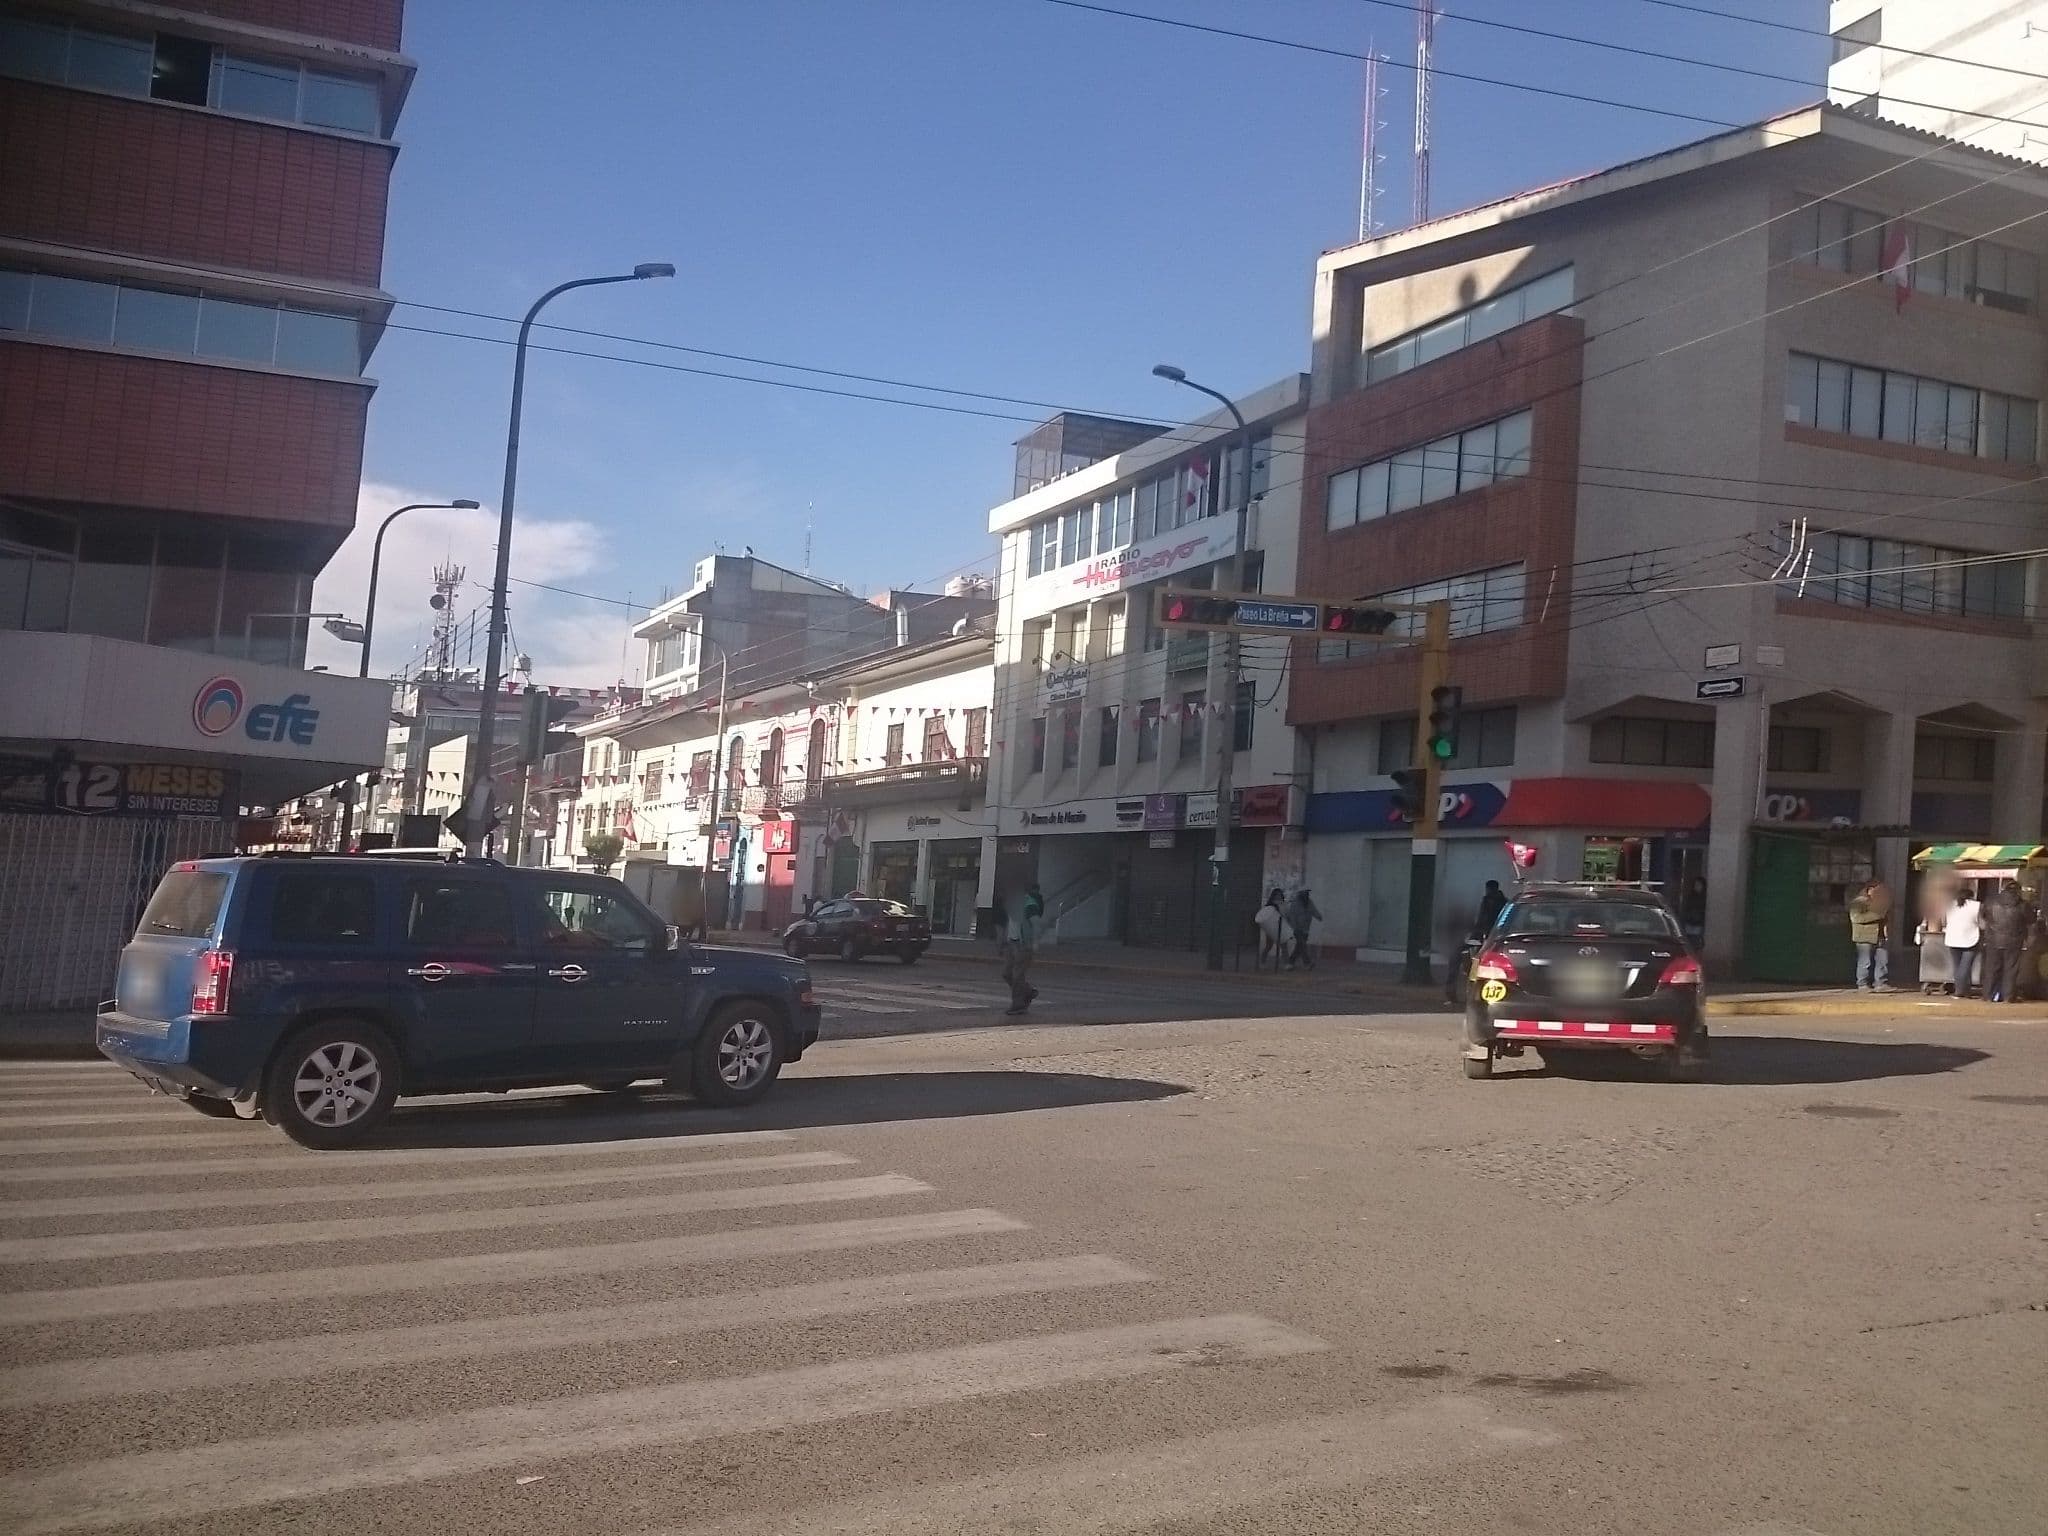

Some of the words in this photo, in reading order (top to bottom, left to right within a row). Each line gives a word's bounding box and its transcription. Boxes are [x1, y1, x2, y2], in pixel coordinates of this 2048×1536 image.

[1073, 537, 1208, 588] Huancayo
[1101, 549, 1140, 569] RADIO
[1238, 605, 1258, 620] Paseo
[1260, 608, 1268, 621] La
[245, 694, 320, 745] efe
[62, 765, 120, 807] 12
[126, 765, 225, 797] MESES
[152, 798, 219, 813] INTERESES
[1485, 986, 1503, 998] 137
